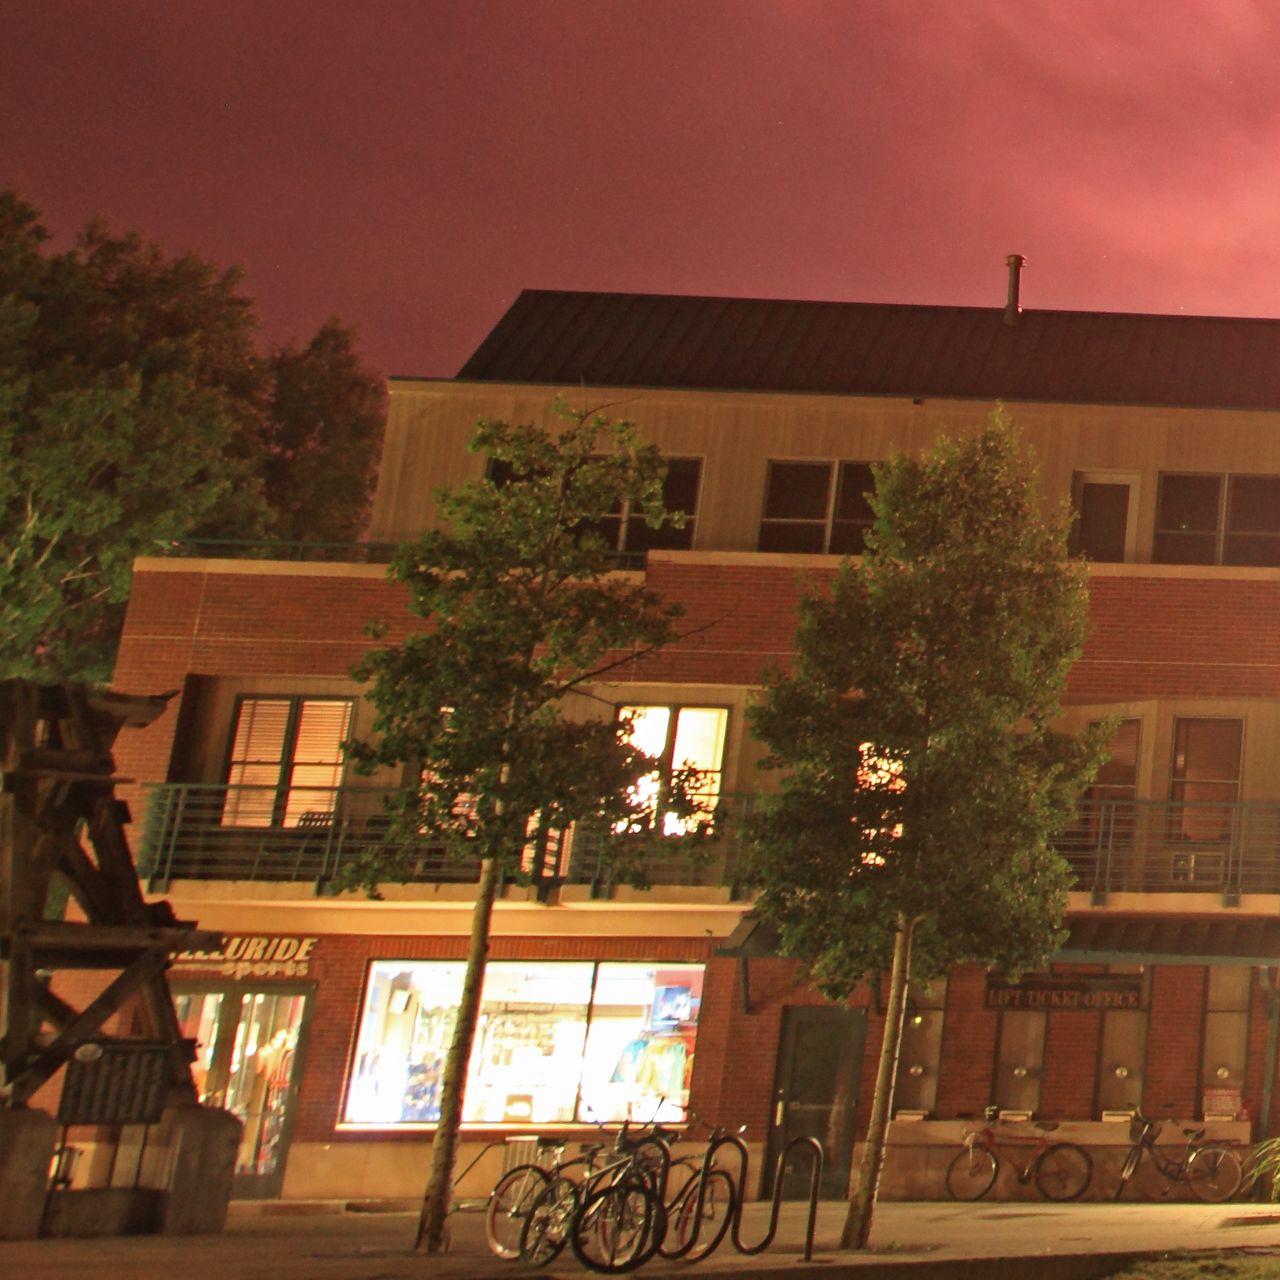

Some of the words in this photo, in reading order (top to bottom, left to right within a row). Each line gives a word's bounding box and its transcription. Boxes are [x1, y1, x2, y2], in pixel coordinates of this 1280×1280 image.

[221, 961, 309, 980] sports
[988, 989, 1021, 1006] LIFT
[1026, 990, 1080, 1007] TICKET
[1083, 990, 1139, 1008] OFFICE
